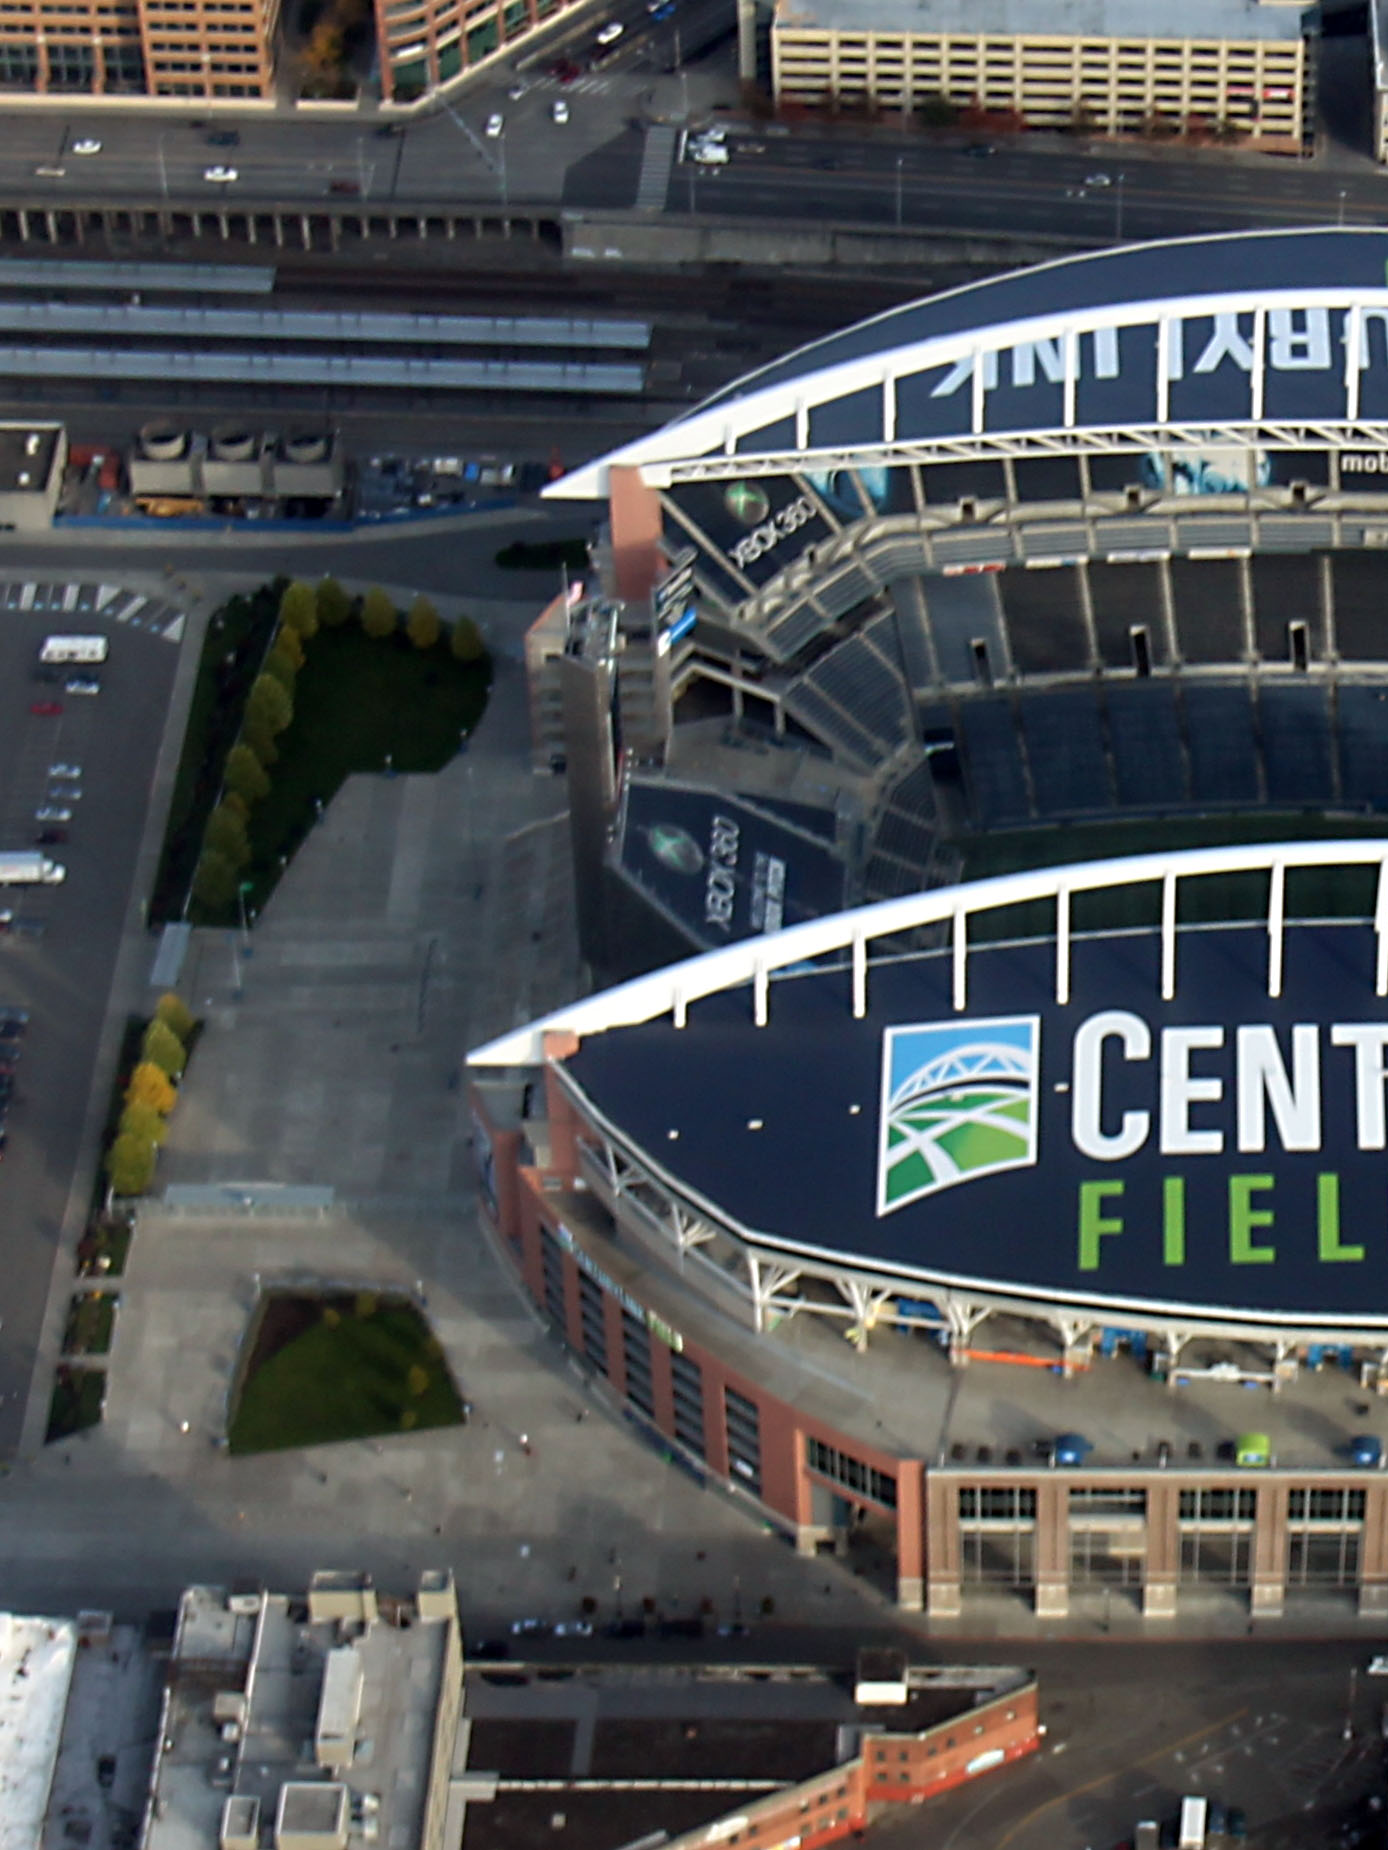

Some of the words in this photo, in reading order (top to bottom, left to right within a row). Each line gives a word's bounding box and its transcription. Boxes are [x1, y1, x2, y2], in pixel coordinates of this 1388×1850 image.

[727, 519, 786, 569] XBOX
[775, 496, 818, 534] 360
[710, 815, 740, 867] 360
[705, 859, 736, 933] XBOX
